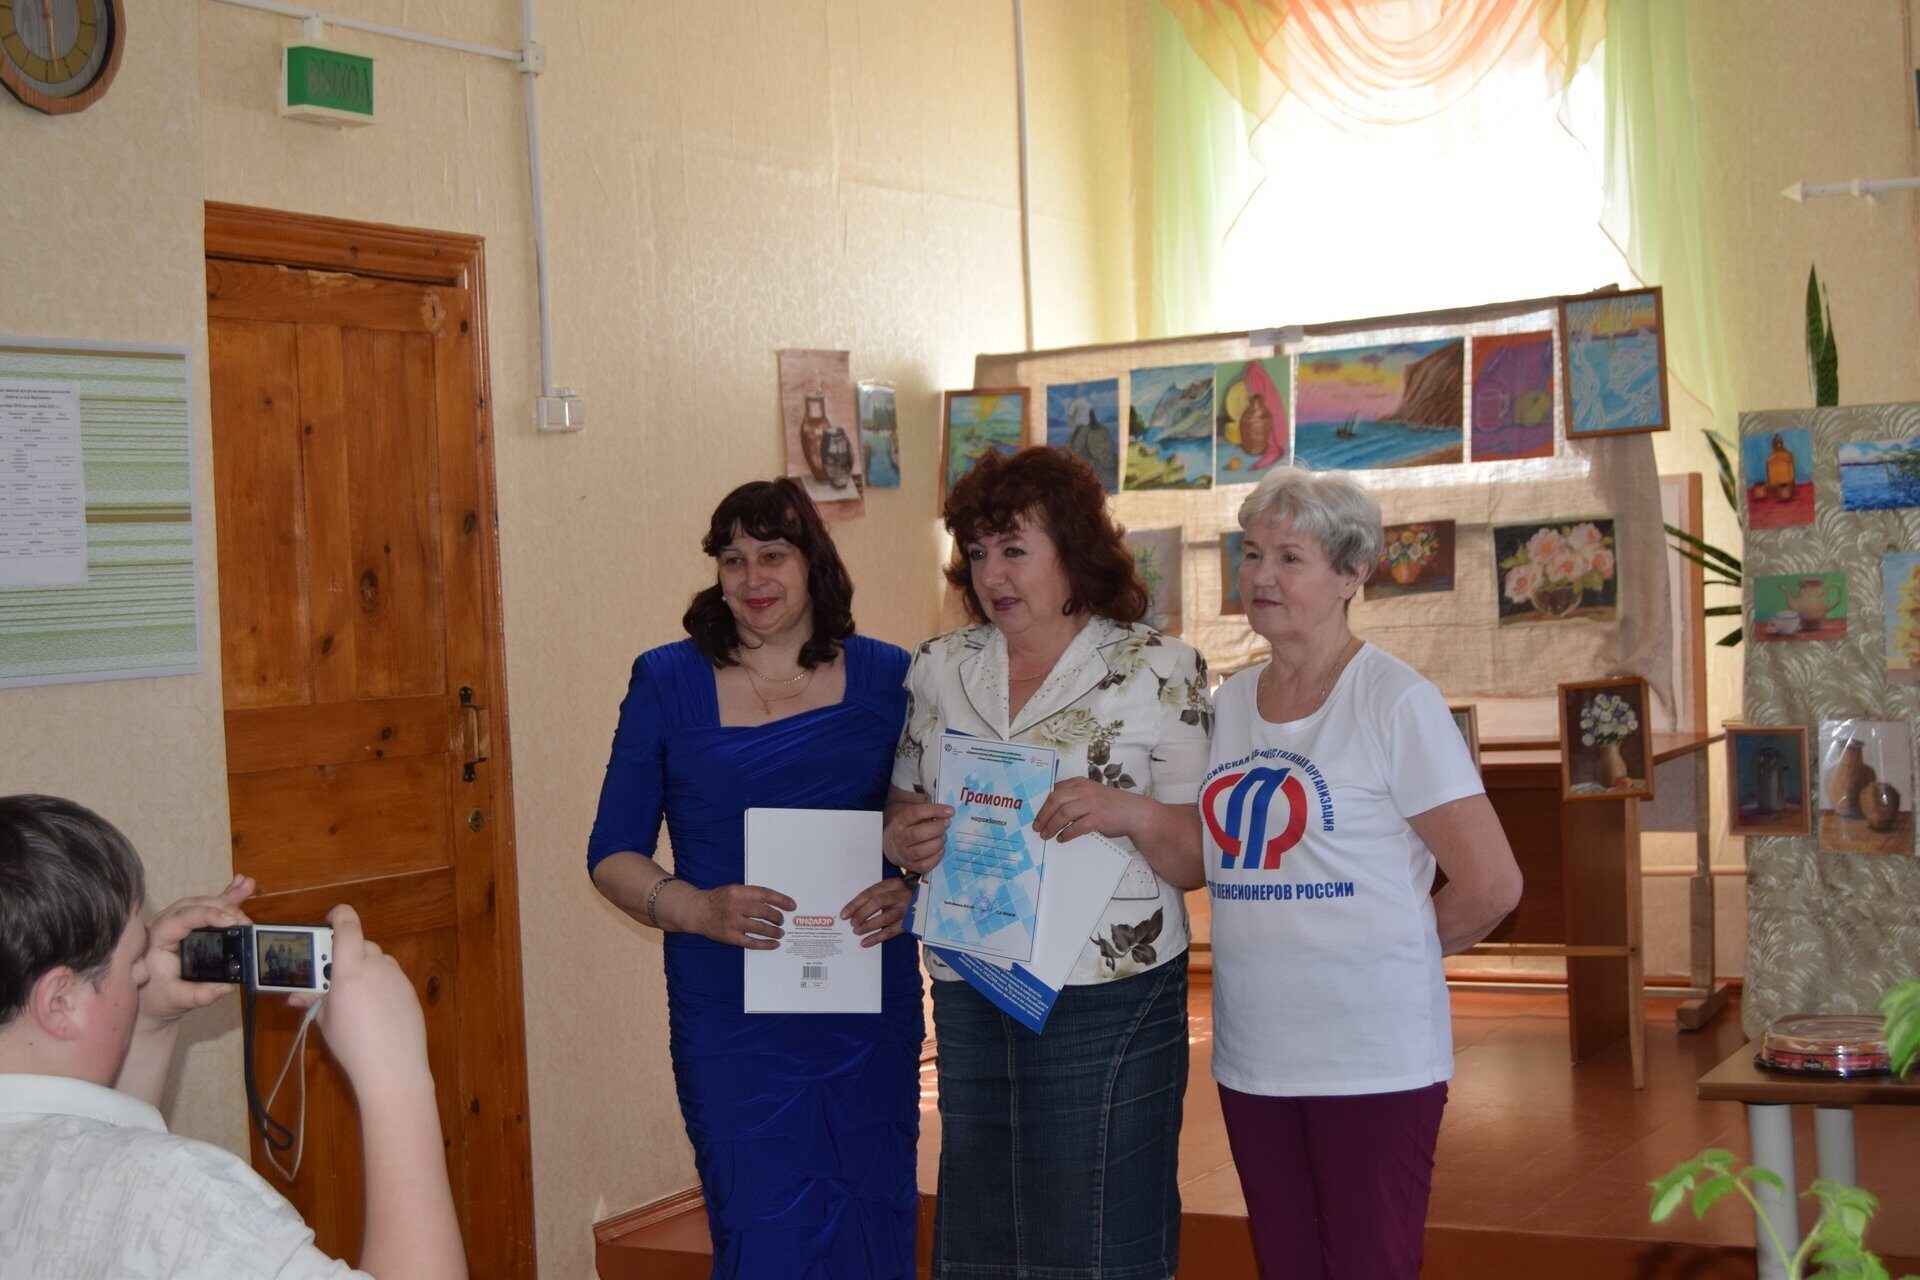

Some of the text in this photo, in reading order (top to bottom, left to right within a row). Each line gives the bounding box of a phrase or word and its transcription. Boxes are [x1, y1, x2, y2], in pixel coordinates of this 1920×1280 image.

[306, 57, 371, 106] ВЫХОД
[960, 786, 1023, 810] Грамота
[1305, 764, 1335, 832] ОРГАНИЗАЦИЯ
[1216, 883, 1293, 901] ПЕНСИОНЕРОВ
[1296, 881, 1355, 900] РОССИИ
